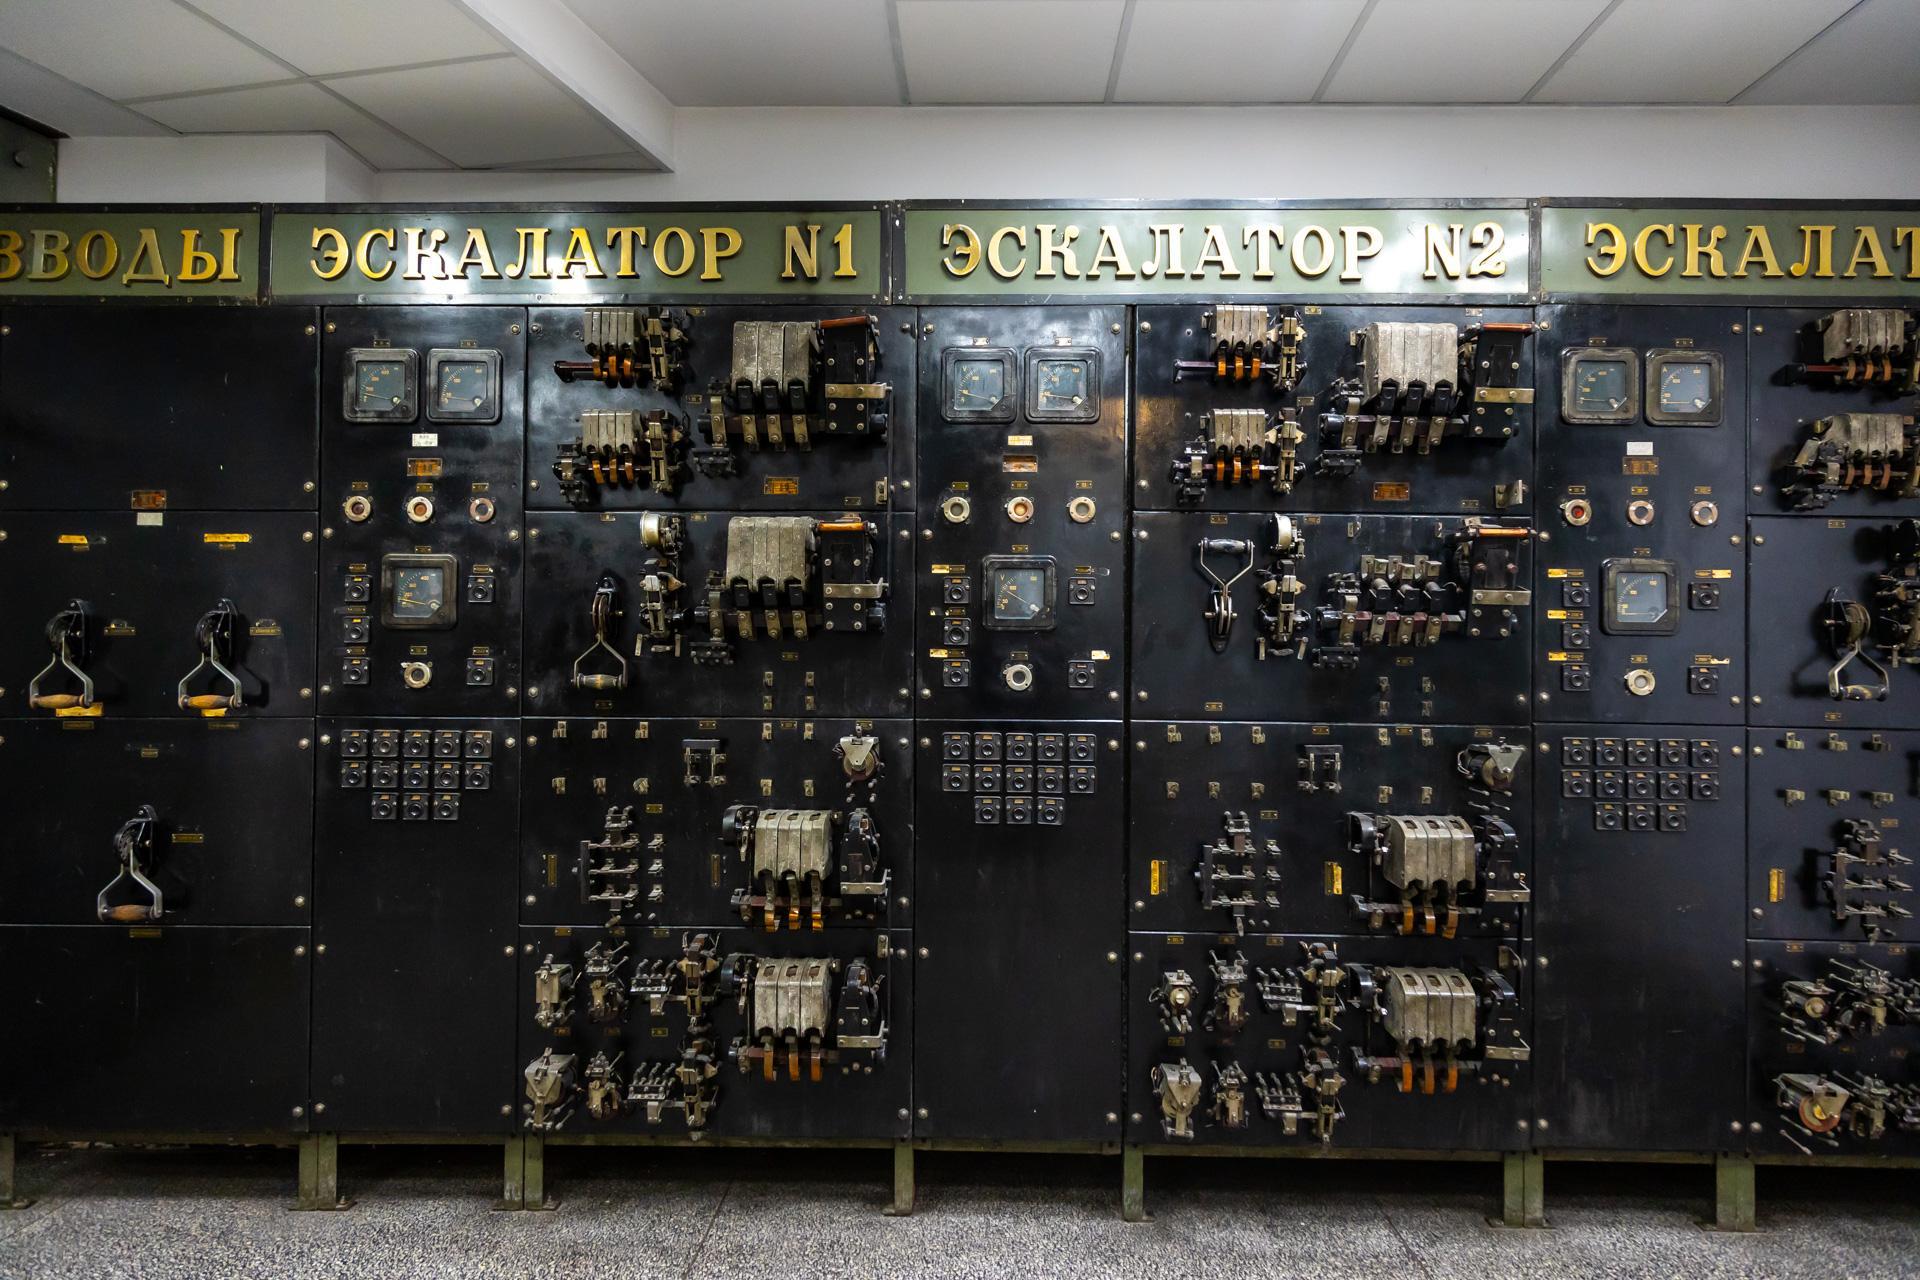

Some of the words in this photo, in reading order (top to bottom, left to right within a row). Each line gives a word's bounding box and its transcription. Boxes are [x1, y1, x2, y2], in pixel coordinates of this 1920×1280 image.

[311, 225, 743, 280] ЭСКАЛАТОР
[781, 223, 858, 278] N1
[942, 224, 1385, 281] ЭСКАЛАТОР
[1423, 222, 1508, 279] N2
